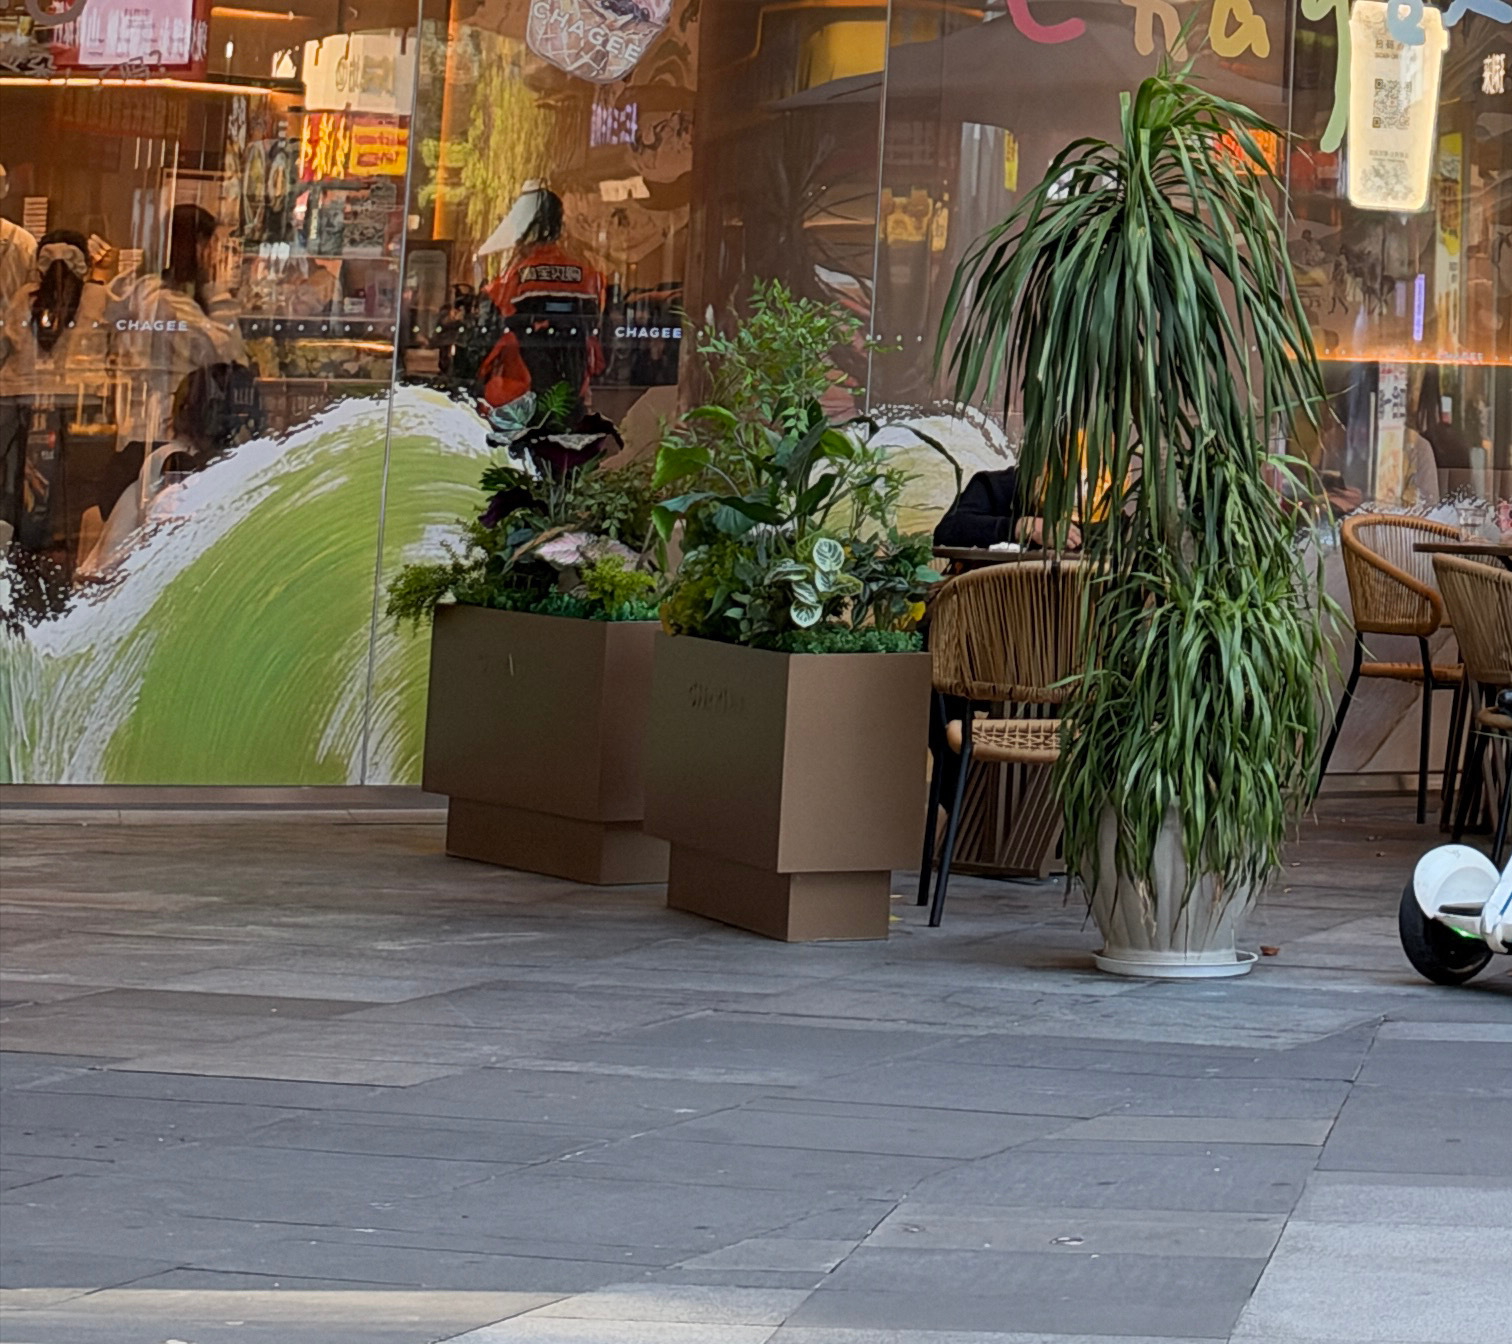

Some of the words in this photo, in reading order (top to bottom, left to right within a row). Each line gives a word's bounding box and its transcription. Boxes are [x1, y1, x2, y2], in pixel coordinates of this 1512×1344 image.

[533, 1, 643, 63] CHAGEE
[116, 319, 189, 332] CHAGEE
[614, 326, 682, 339] CHAGEE
